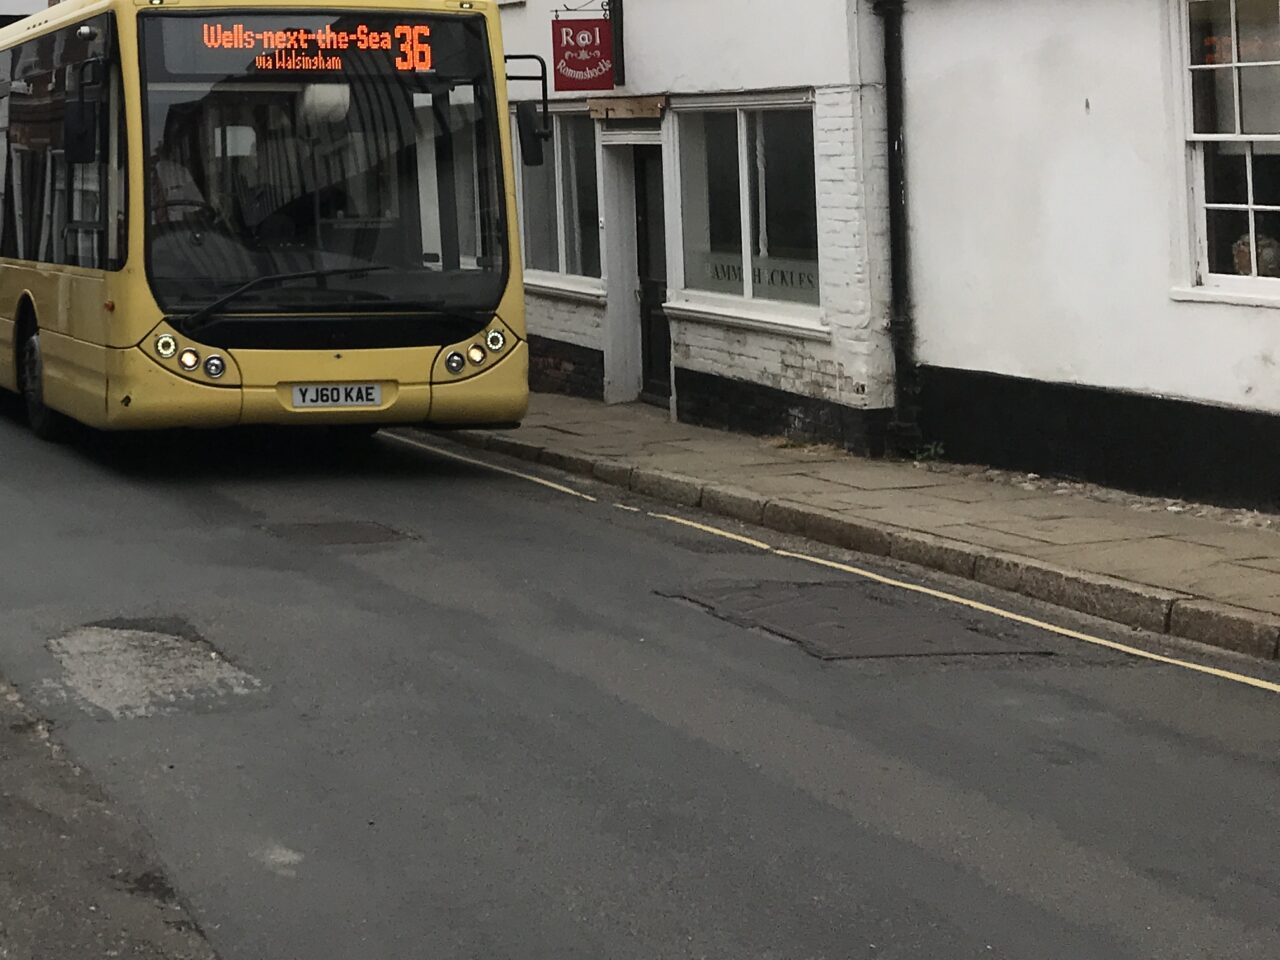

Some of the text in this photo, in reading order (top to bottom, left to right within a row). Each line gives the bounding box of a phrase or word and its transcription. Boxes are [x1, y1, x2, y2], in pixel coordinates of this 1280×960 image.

[203, 23, 433, 71] Wells-next-the-Sea 36
[255, 49, 342, 70] via Walsingham
[299, 386, 375, 403] YJ60 KAE
